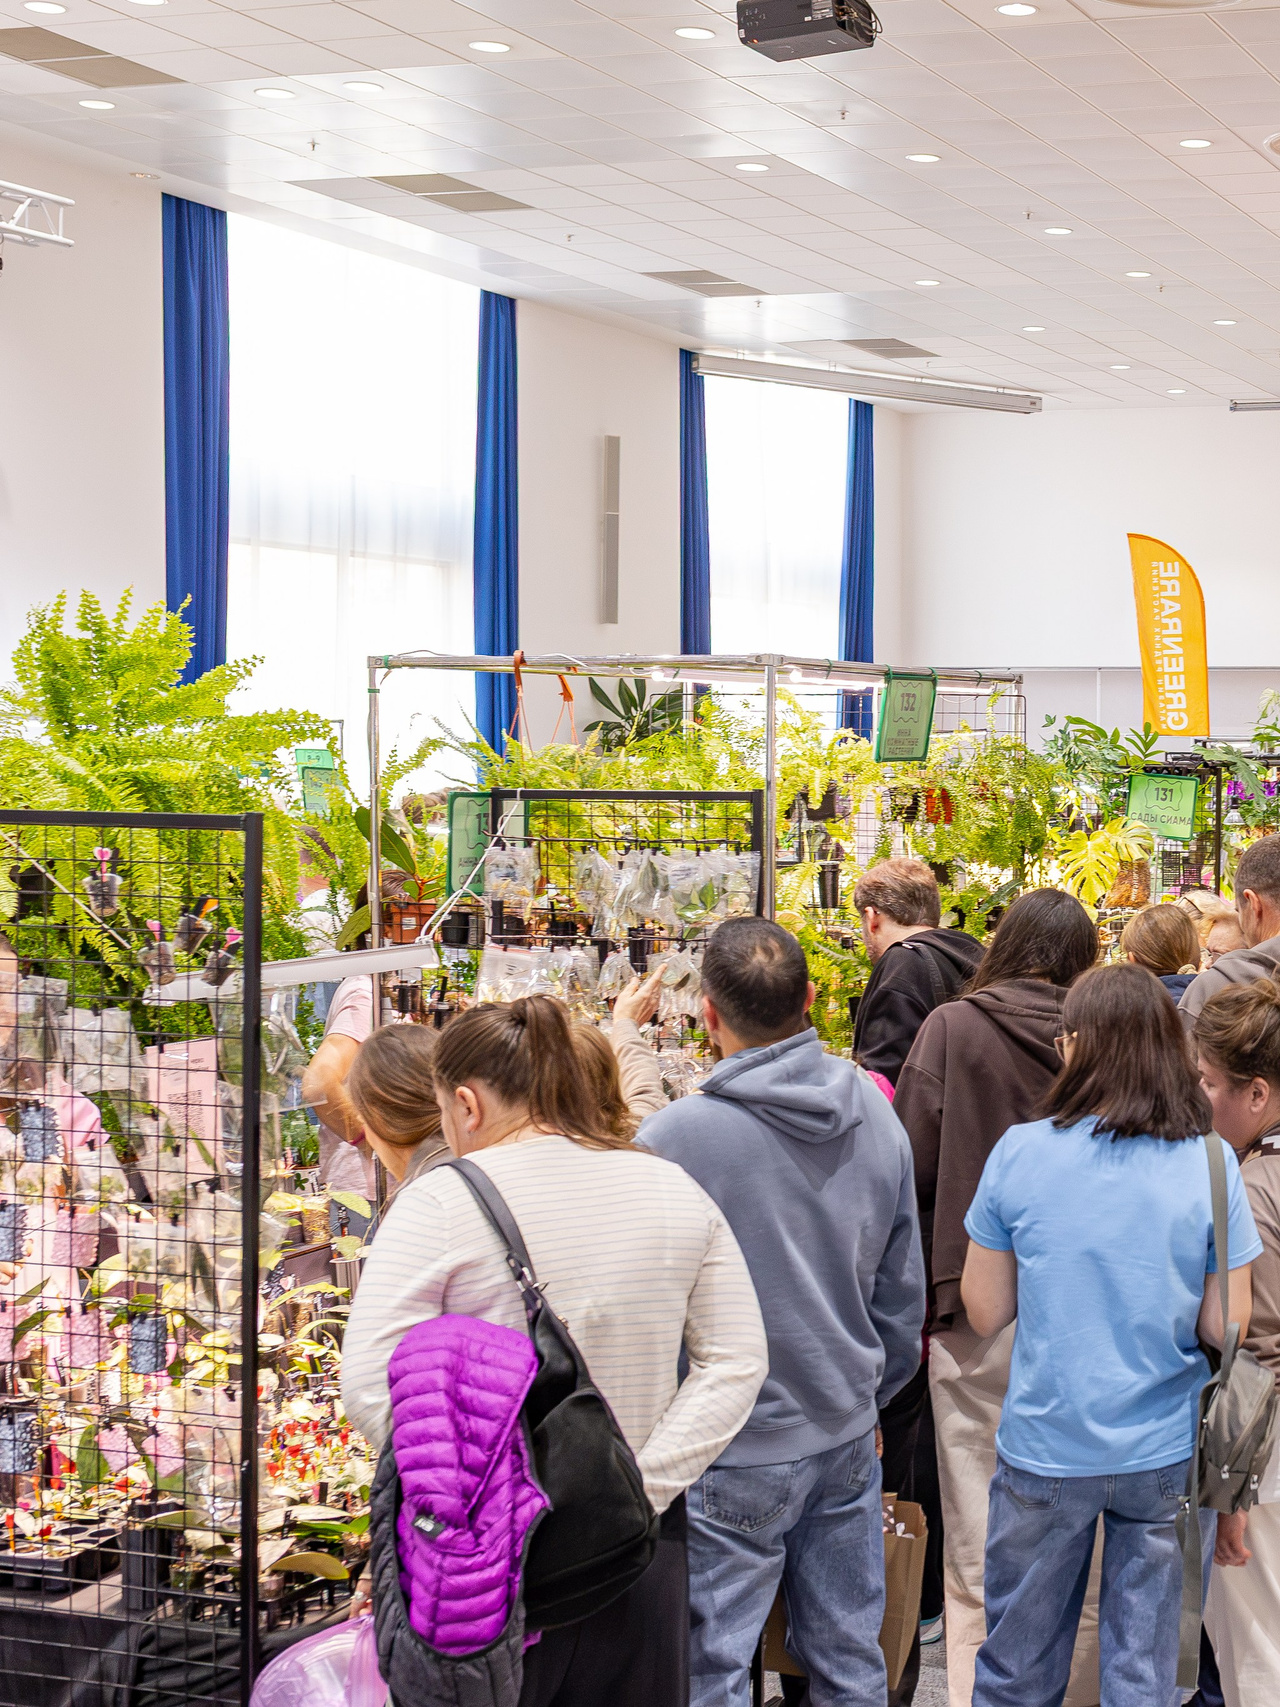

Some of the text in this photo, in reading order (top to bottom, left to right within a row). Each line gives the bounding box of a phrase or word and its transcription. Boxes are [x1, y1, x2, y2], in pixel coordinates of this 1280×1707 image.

[900, 692, 917, 712] 132
[1154, 787, 1174, 802] 131
[1130, 811, 1192, 826] САДЫ СИАМА
